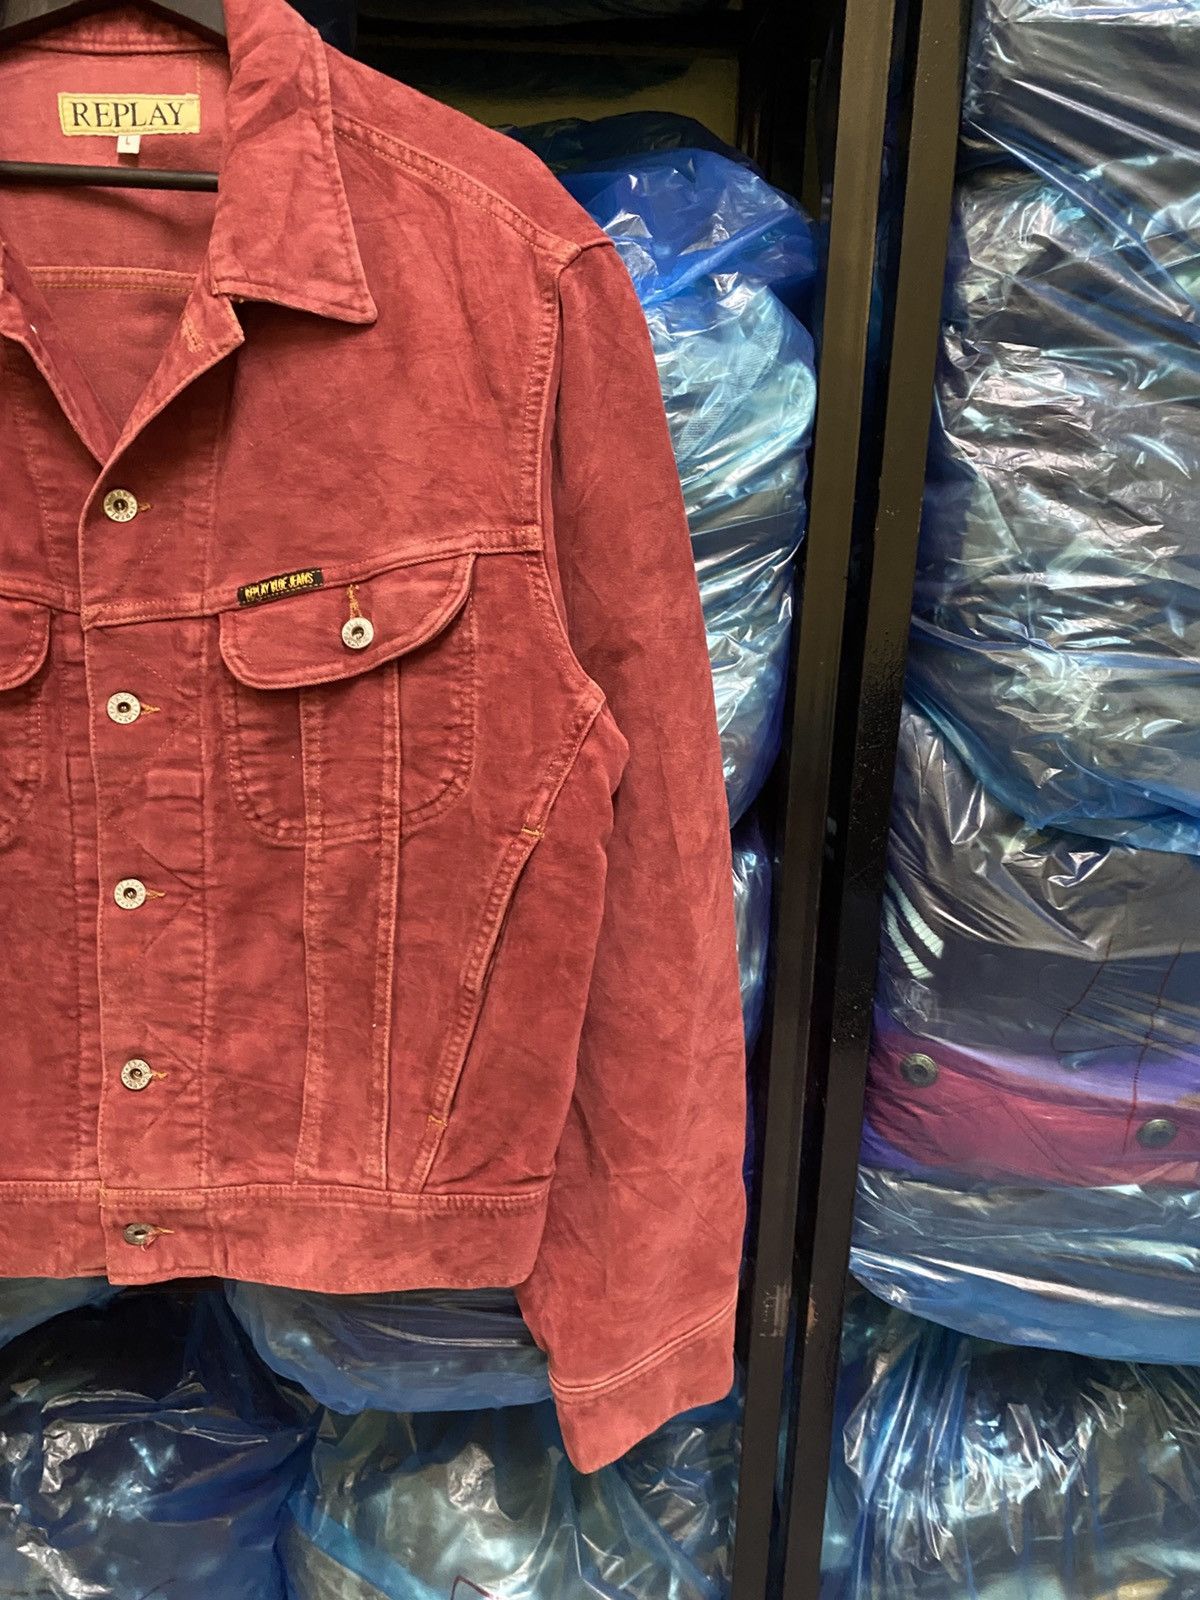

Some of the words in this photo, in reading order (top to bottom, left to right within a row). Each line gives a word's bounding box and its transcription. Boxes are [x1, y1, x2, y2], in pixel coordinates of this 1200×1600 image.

[71, 101, 184, 128] REPLAY
[244, 583, 269, 601] REPLAY
[288, 572, 314, 589] JEANS
